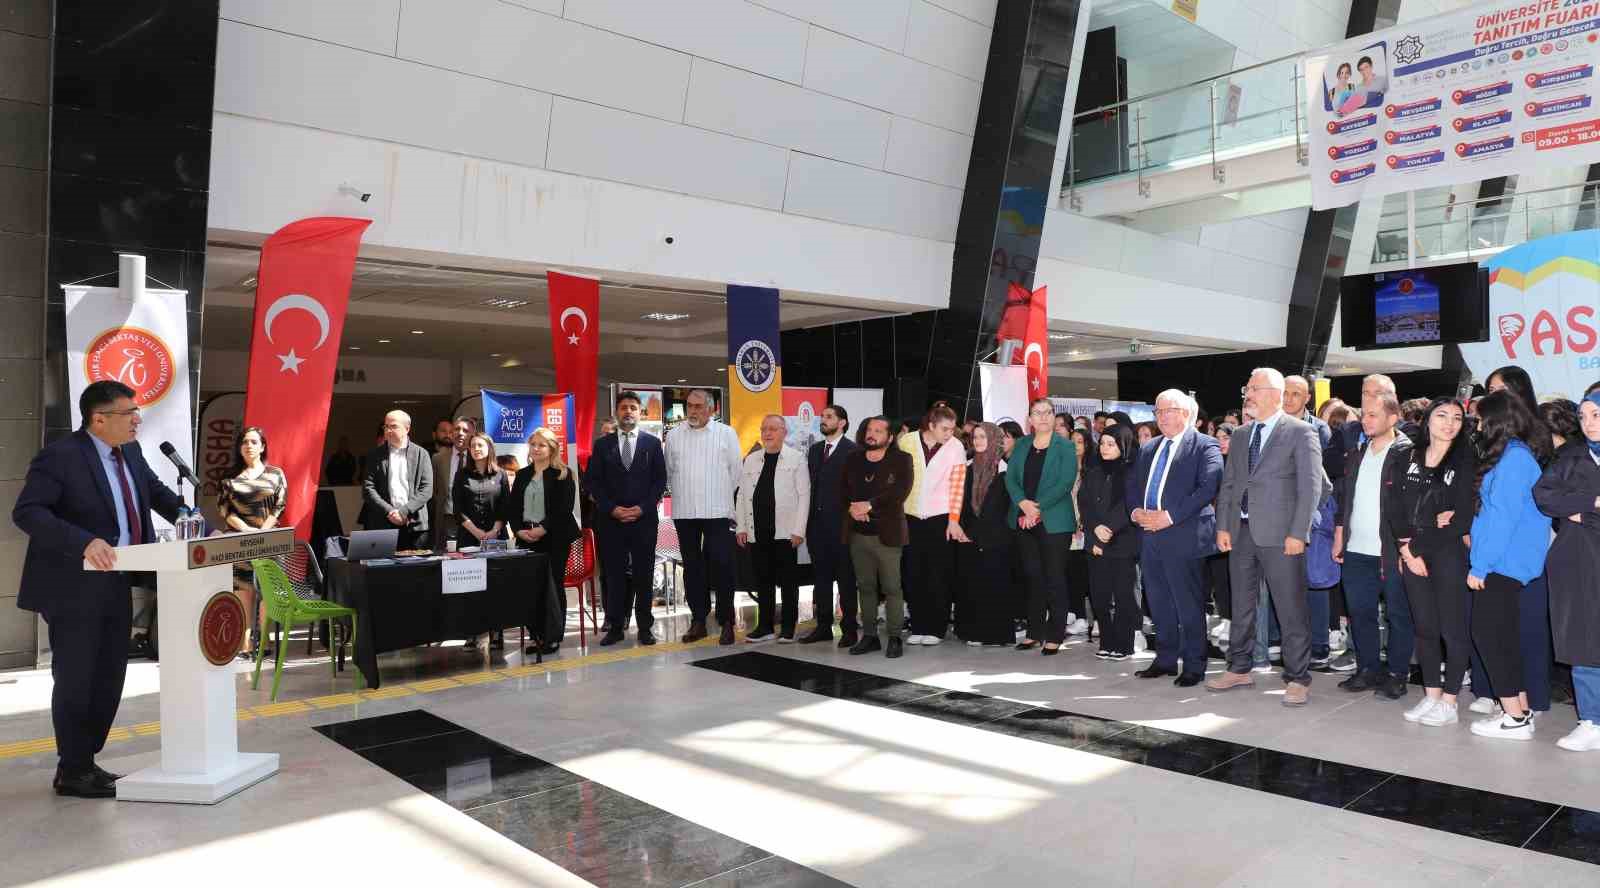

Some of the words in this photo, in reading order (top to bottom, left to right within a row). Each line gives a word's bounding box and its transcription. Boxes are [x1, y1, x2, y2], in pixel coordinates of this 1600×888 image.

[1473, 18, 1540, 45] TANITIM
[1544, 3, 1599, 28] FUARI
[1538, 136, 1569, 148] 09.00
[501, 418, 524, 431] AGÜ
